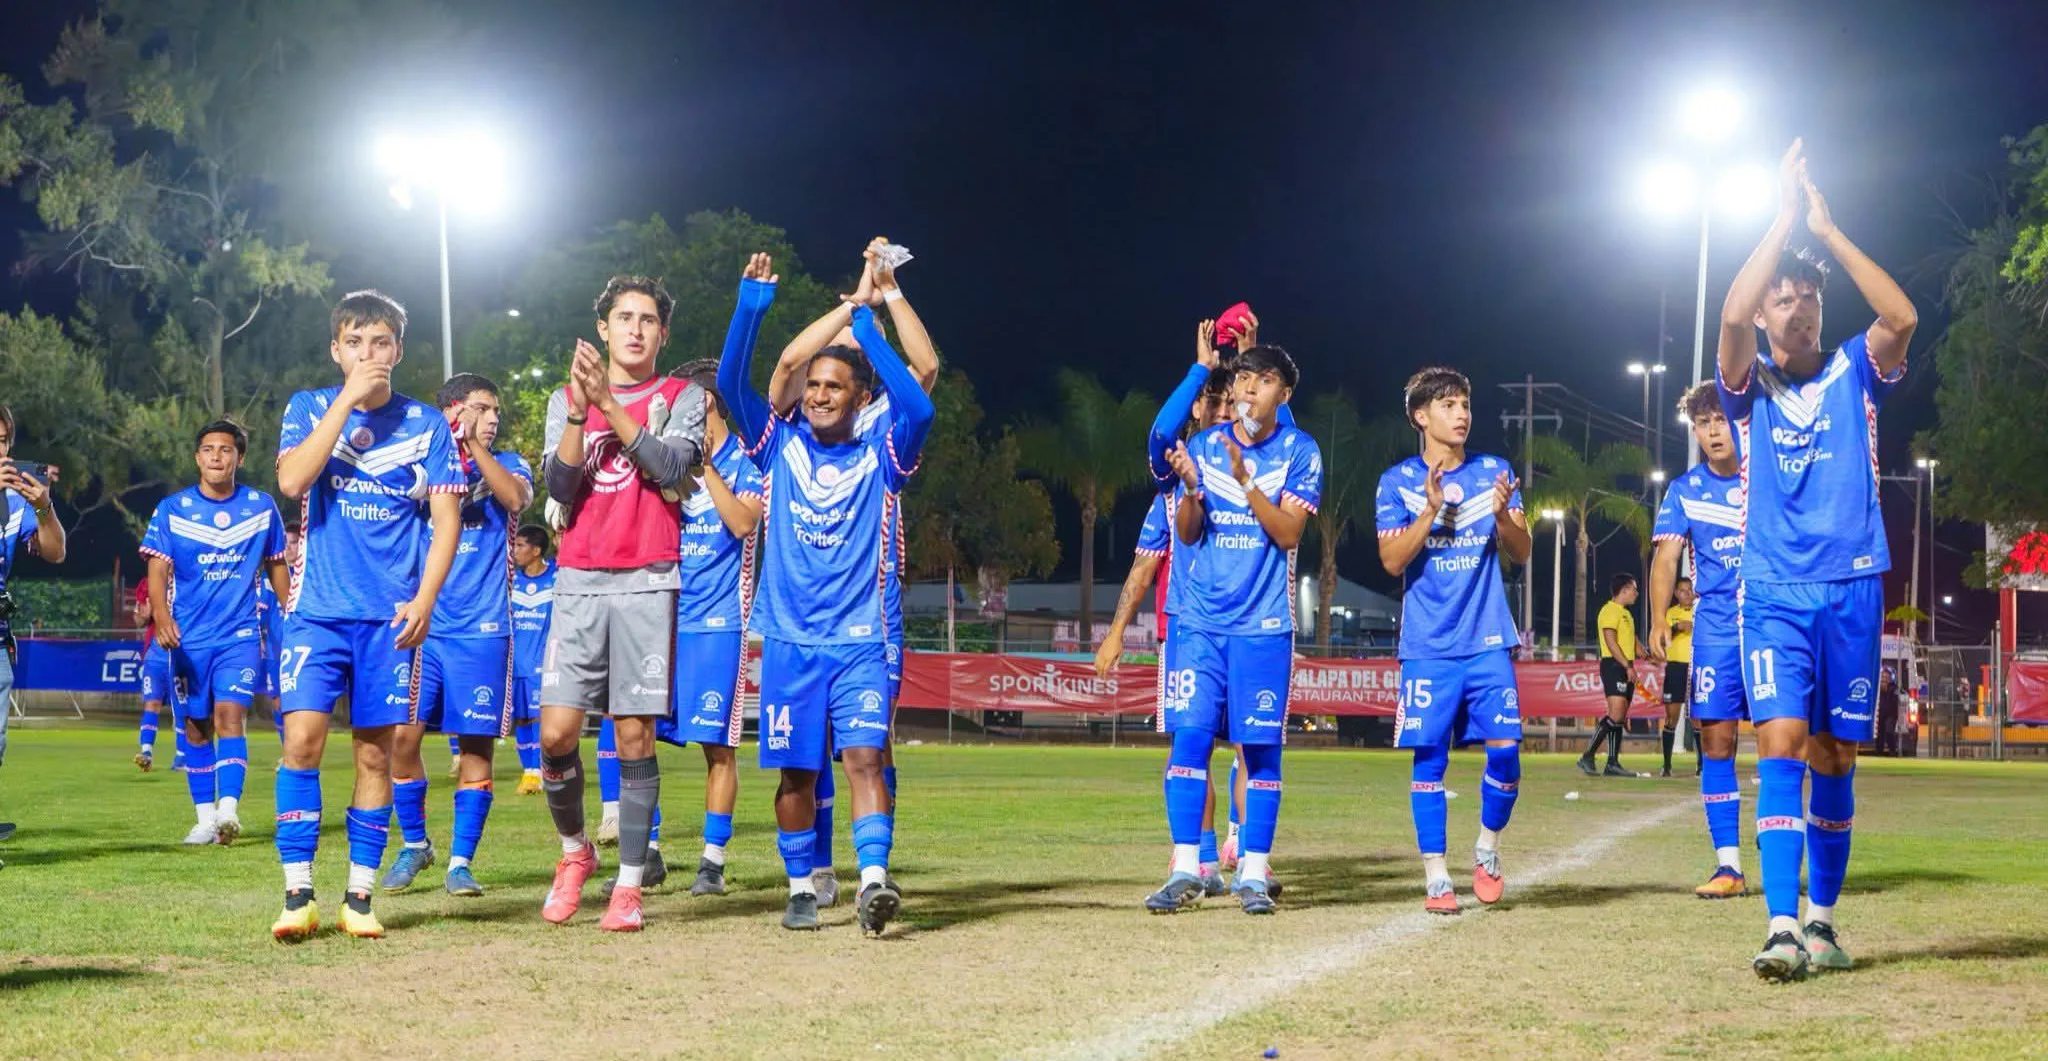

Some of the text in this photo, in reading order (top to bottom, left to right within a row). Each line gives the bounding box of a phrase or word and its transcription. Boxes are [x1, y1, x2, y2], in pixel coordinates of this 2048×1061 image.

[336, 499, 392, 521] Traitte
[1431, 555, 1481, 573] Traitte
[279, 645, 313, 679] 27
[1749, 648, 1775, 685] 11
[1351, 670, 1379, 689] DEL
[1695, 665, 1716, 693] 16
[1293, 688, 1373, 702] STAURANT
[1405, 678, 1432, 709] 15
[766, 704, 794, 738] 14
